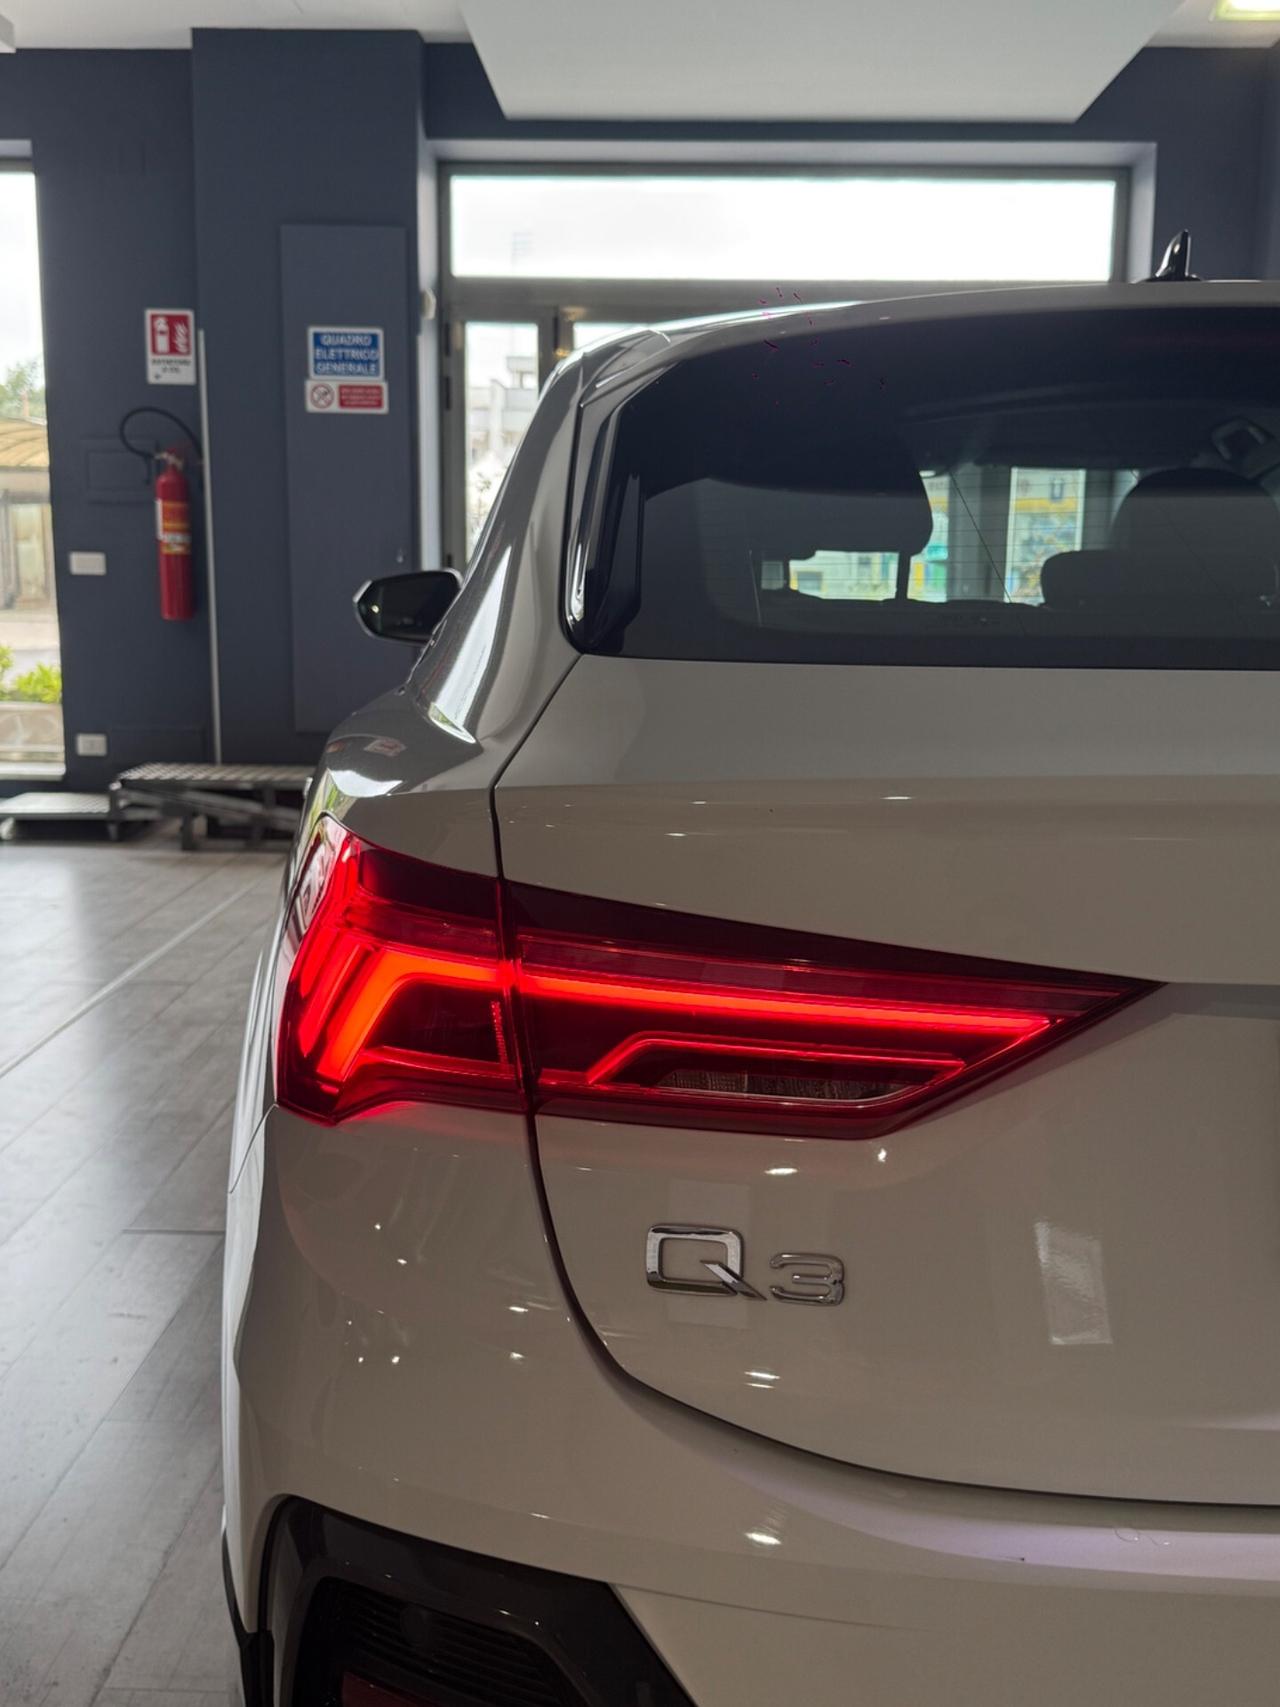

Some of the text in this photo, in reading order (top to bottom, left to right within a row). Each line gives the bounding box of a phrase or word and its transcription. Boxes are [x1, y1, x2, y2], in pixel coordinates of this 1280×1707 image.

[320, 334, 372, 346] QUADRO
[315, 347, 379, 360] ELETTRICO
[316, 362, 377, 375] GENERALE
[646, 1223, 845, 1306] Q3
